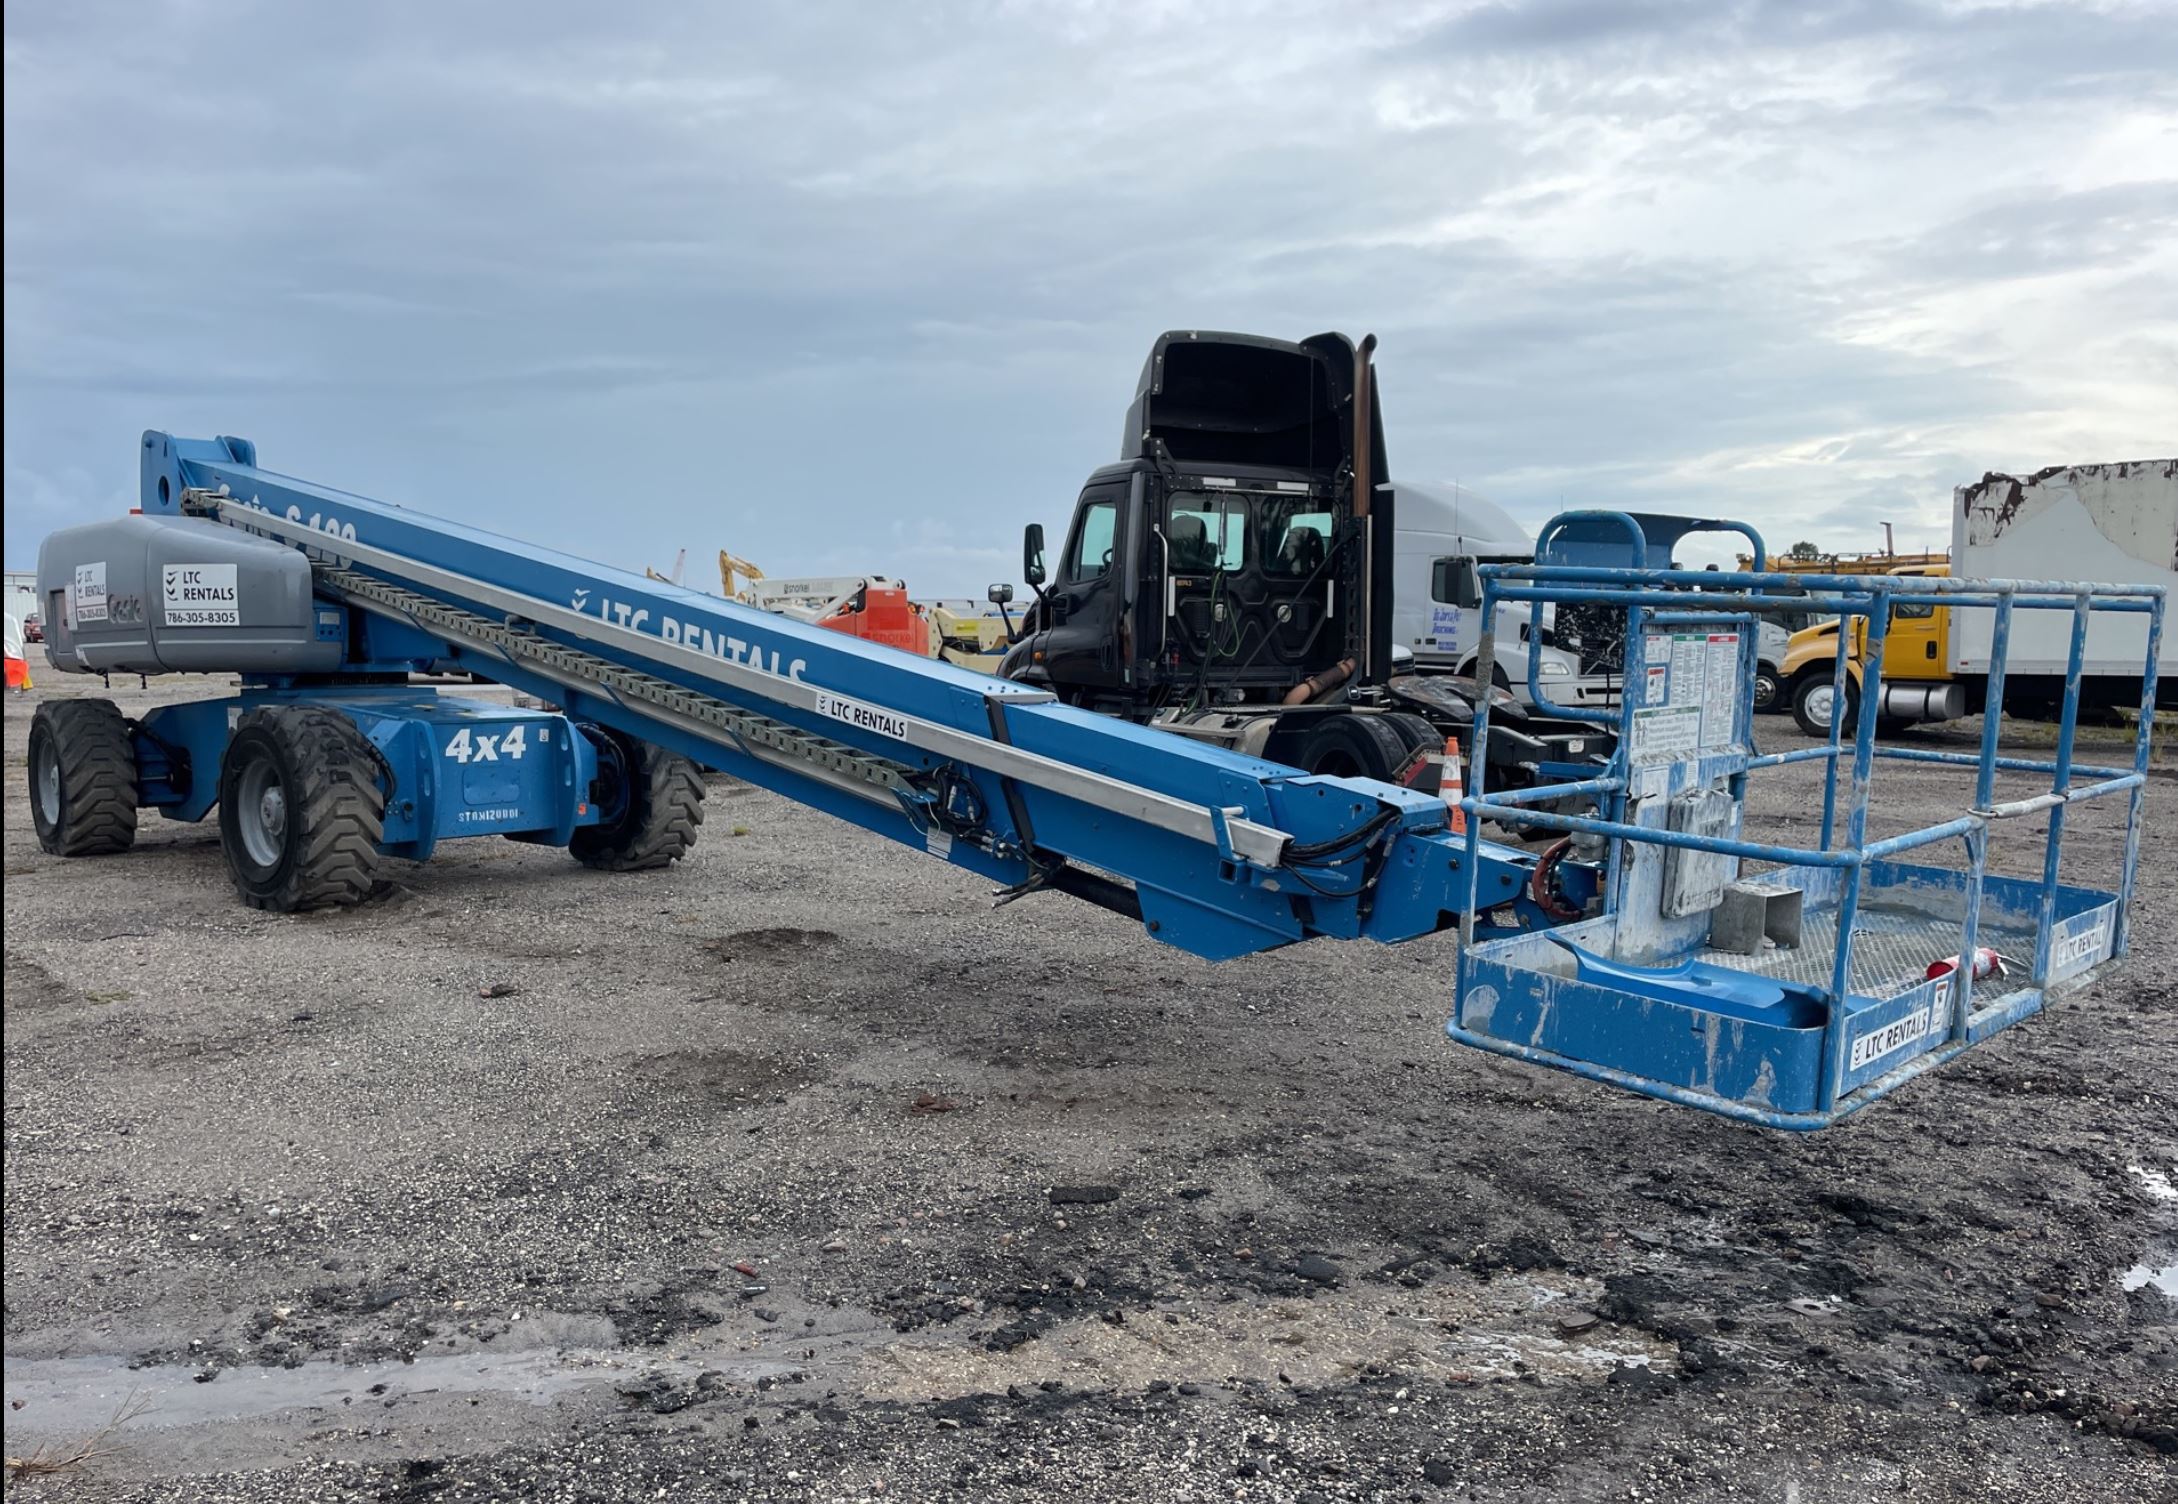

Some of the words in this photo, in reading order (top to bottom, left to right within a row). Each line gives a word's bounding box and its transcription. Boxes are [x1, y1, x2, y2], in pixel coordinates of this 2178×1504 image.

[183, 571, 200, 584] LTC
[85, 584, 105, 597] RENTALS
[183, 588, 234, 600] RENTALS
[168, 612, 236, 623] 786-305-8305
[831, 700, 850, 720] LTC
[853, 708, 905, 738] RENTALS
[445, 725, 526, 763] 4x4
[1865, 1032, 1884, 1060] LTC
[1886, 1011, 1927, 1050] RENTALS
